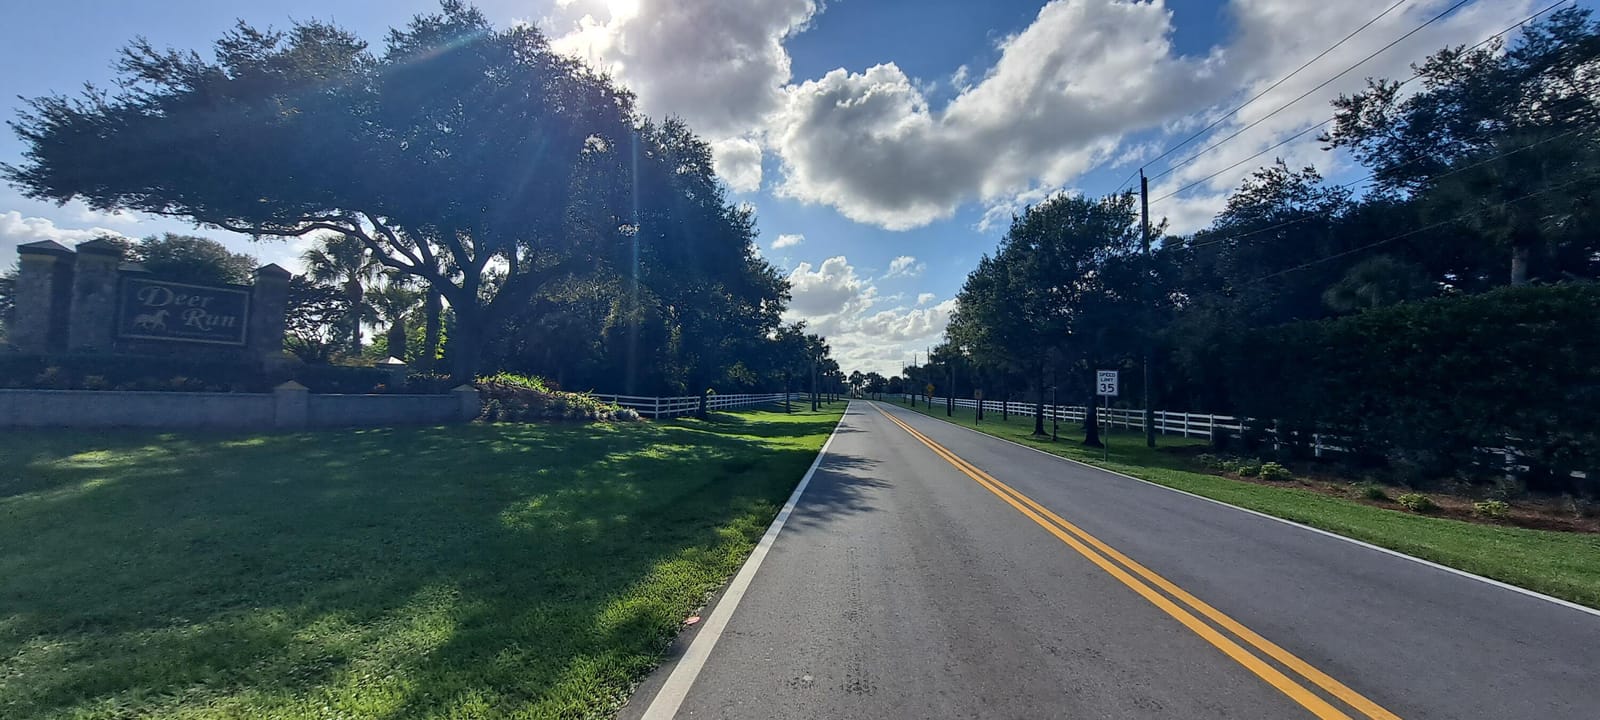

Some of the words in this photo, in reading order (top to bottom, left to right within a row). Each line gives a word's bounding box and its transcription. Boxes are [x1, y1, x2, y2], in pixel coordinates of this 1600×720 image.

[137, 285, 214, 308] Deer
[182, 307, 237, 332] Run
[1100, 383, 1115, 393] 35
